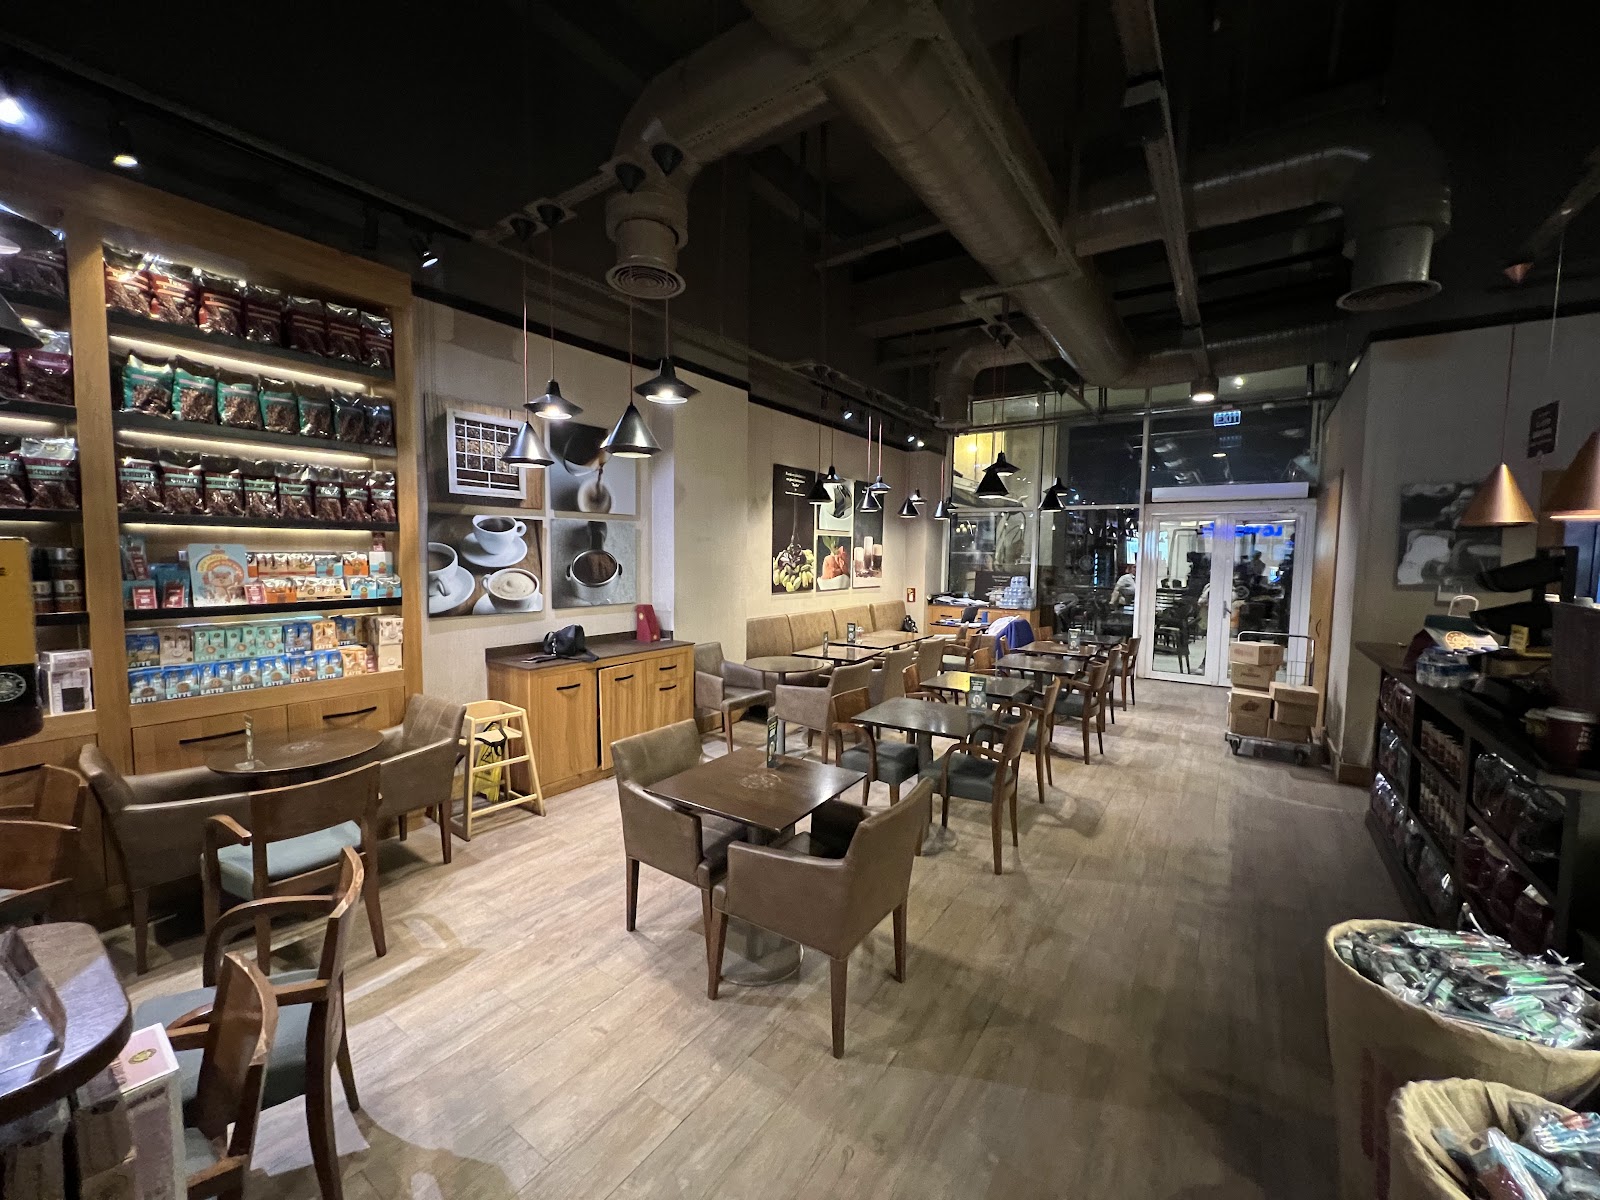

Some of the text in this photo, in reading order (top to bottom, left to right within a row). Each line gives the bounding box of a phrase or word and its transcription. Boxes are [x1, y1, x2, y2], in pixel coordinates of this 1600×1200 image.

[1215, 412, 1239, 424] EXIT
[200, 687, 224, 695] LATTE
[233, 683, 255, 691] LATTE
[130, 695, 157, 704] LATTE
[166, 691, 192, 700] LATTE
